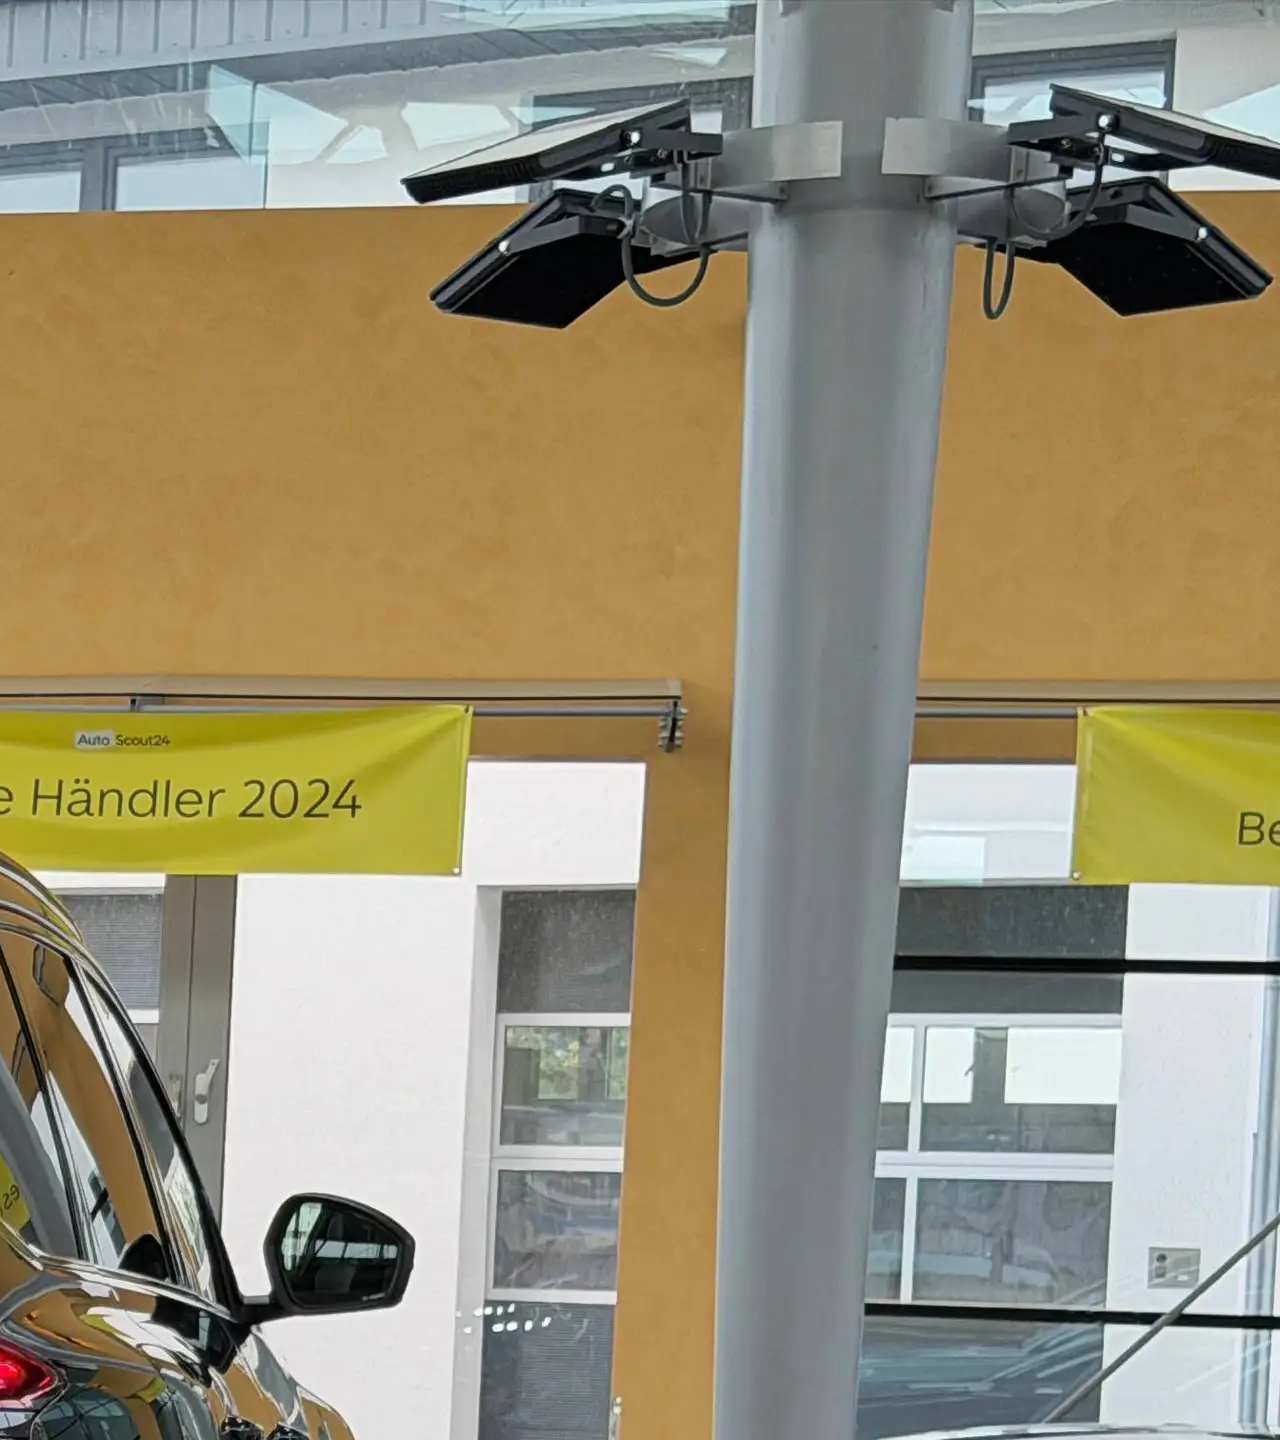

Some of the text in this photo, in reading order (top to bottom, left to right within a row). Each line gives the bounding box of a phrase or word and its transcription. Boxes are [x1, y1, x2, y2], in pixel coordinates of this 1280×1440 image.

[77, 734, 171, 746] Auto Scout24
[32, 778, 226, 818] Händler
[237, 779, 362, 819] 2024
